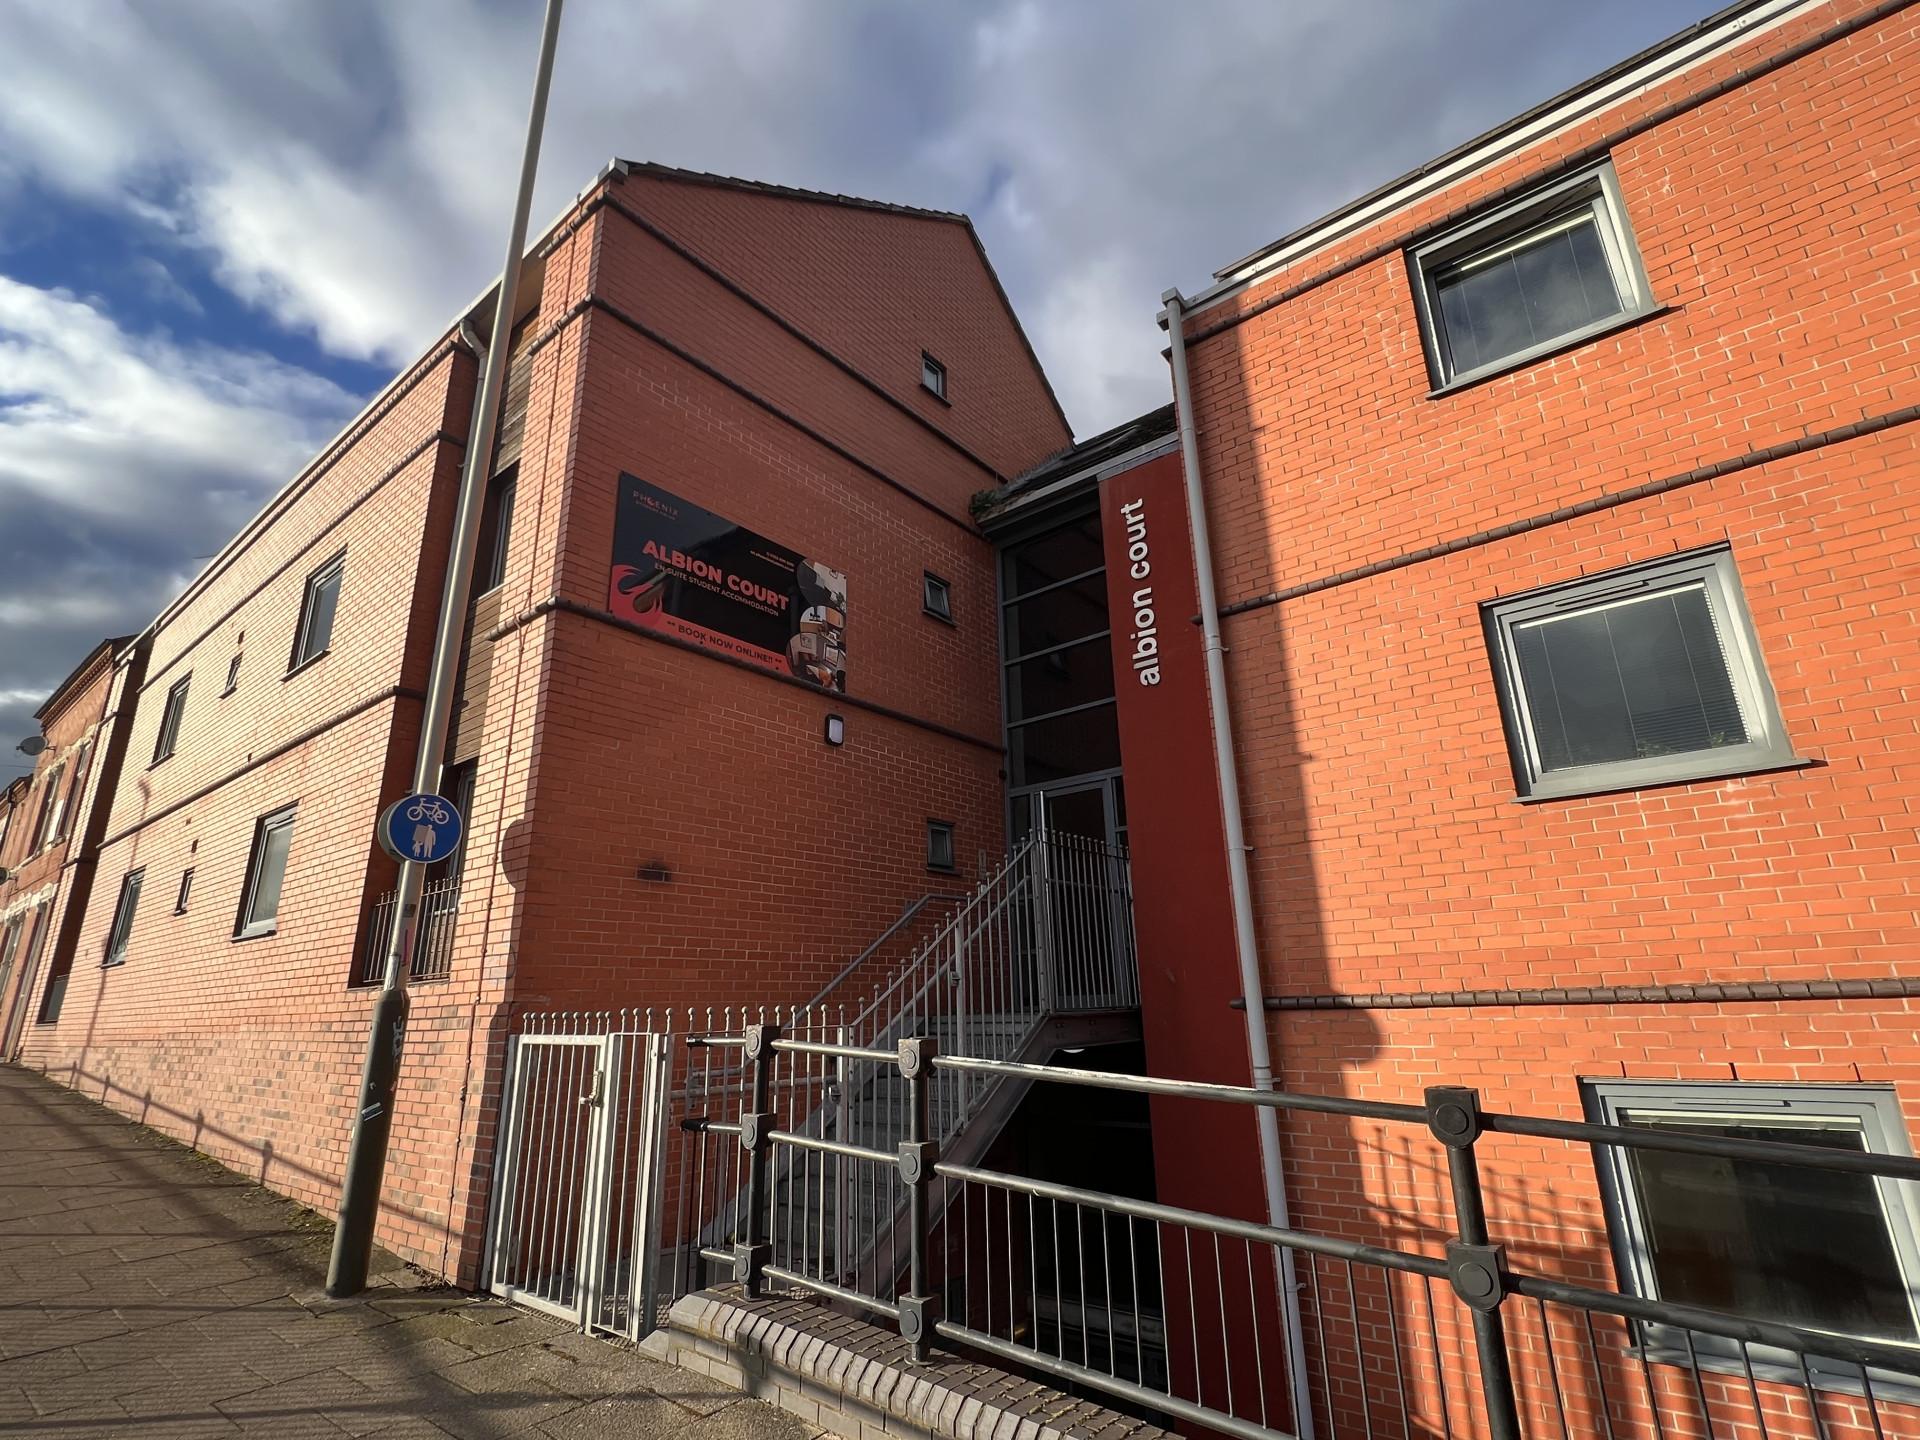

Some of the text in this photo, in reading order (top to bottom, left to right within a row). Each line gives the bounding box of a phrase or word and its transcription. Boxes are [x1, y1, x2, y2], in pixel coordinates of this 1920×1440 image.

[642, 540, 723, 584] ALBION
[727, 574, 789, 610] COURT
[689, 576, 721, 594] STUDENT
[721, 590, 779, 616] ACCOMMODATION
[1120, 498, 1161, 686] albion court
[678, 624, 706, 640] BOOK
[709, 635, 733, 649] NOW
